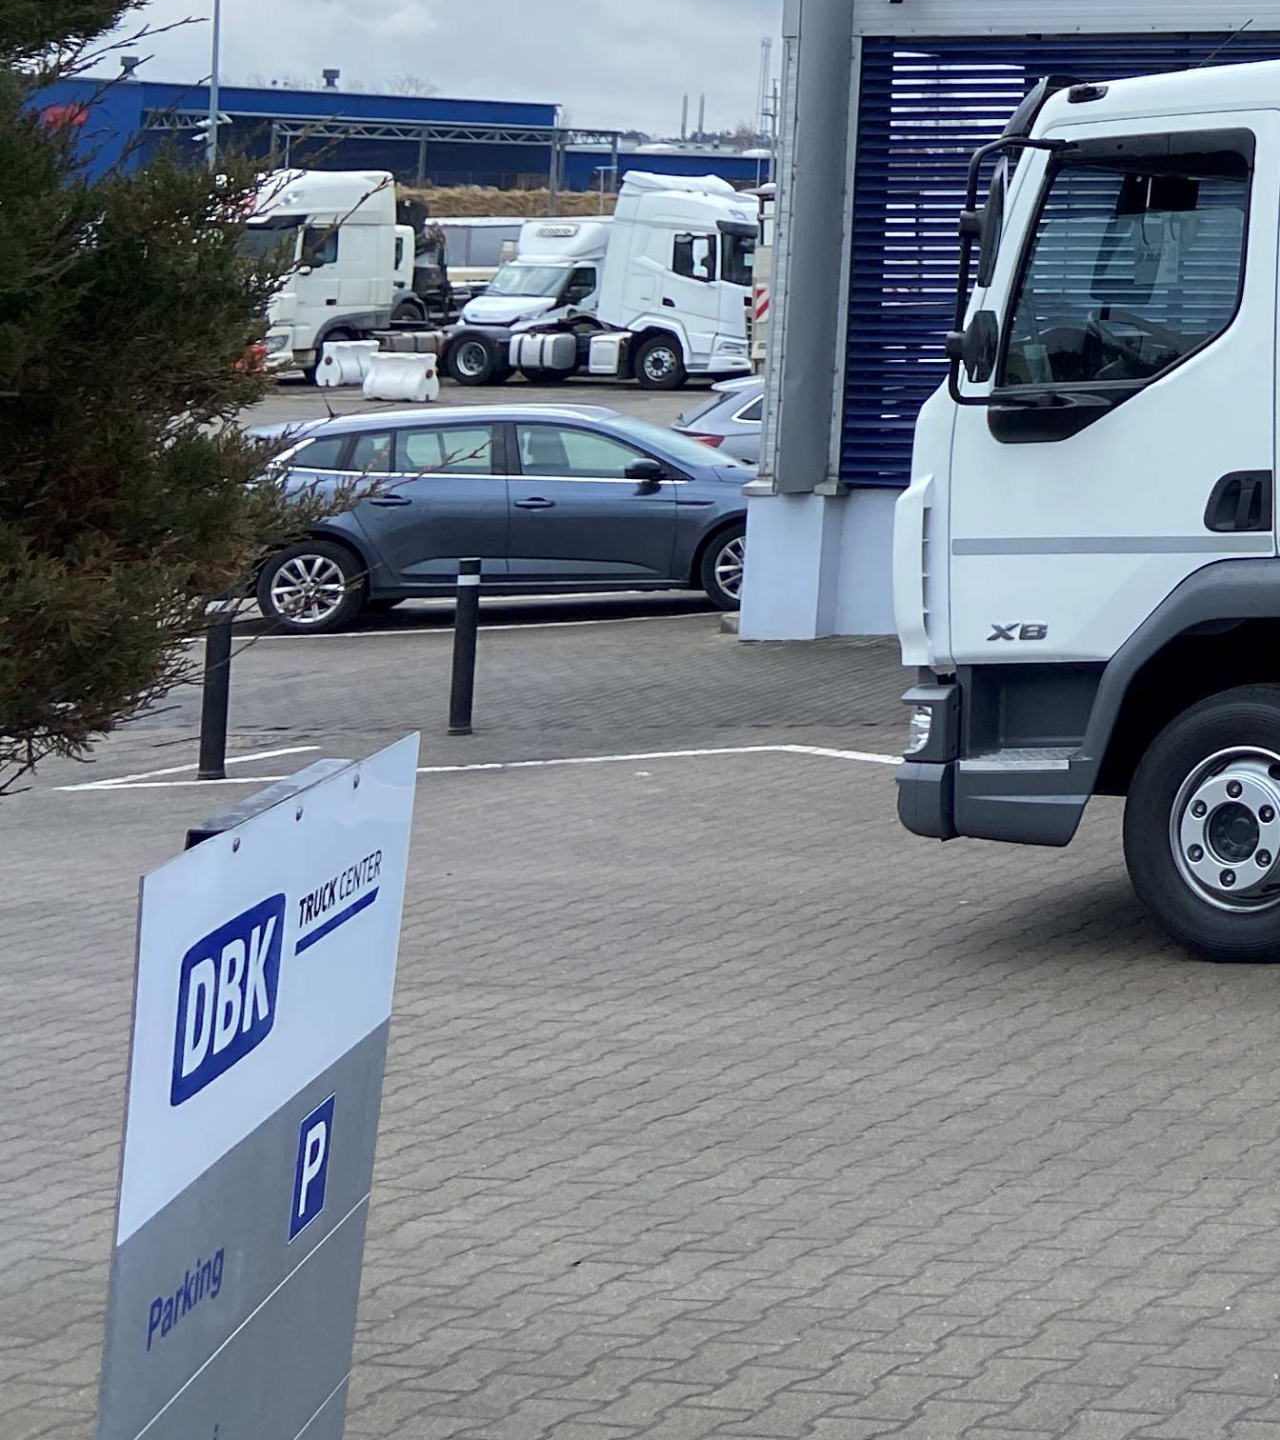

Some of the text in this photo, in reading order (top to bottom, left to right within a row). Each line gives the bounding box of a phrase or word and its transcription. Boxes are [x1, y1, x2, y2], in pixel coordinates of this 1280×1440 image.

[299, 849, 383, 929] TRUCK CENTER
[181, 914, 277, 1078] DBK
[298, 1120, 327, 1218] P
[146, 1247, 225, 1351] Parking
